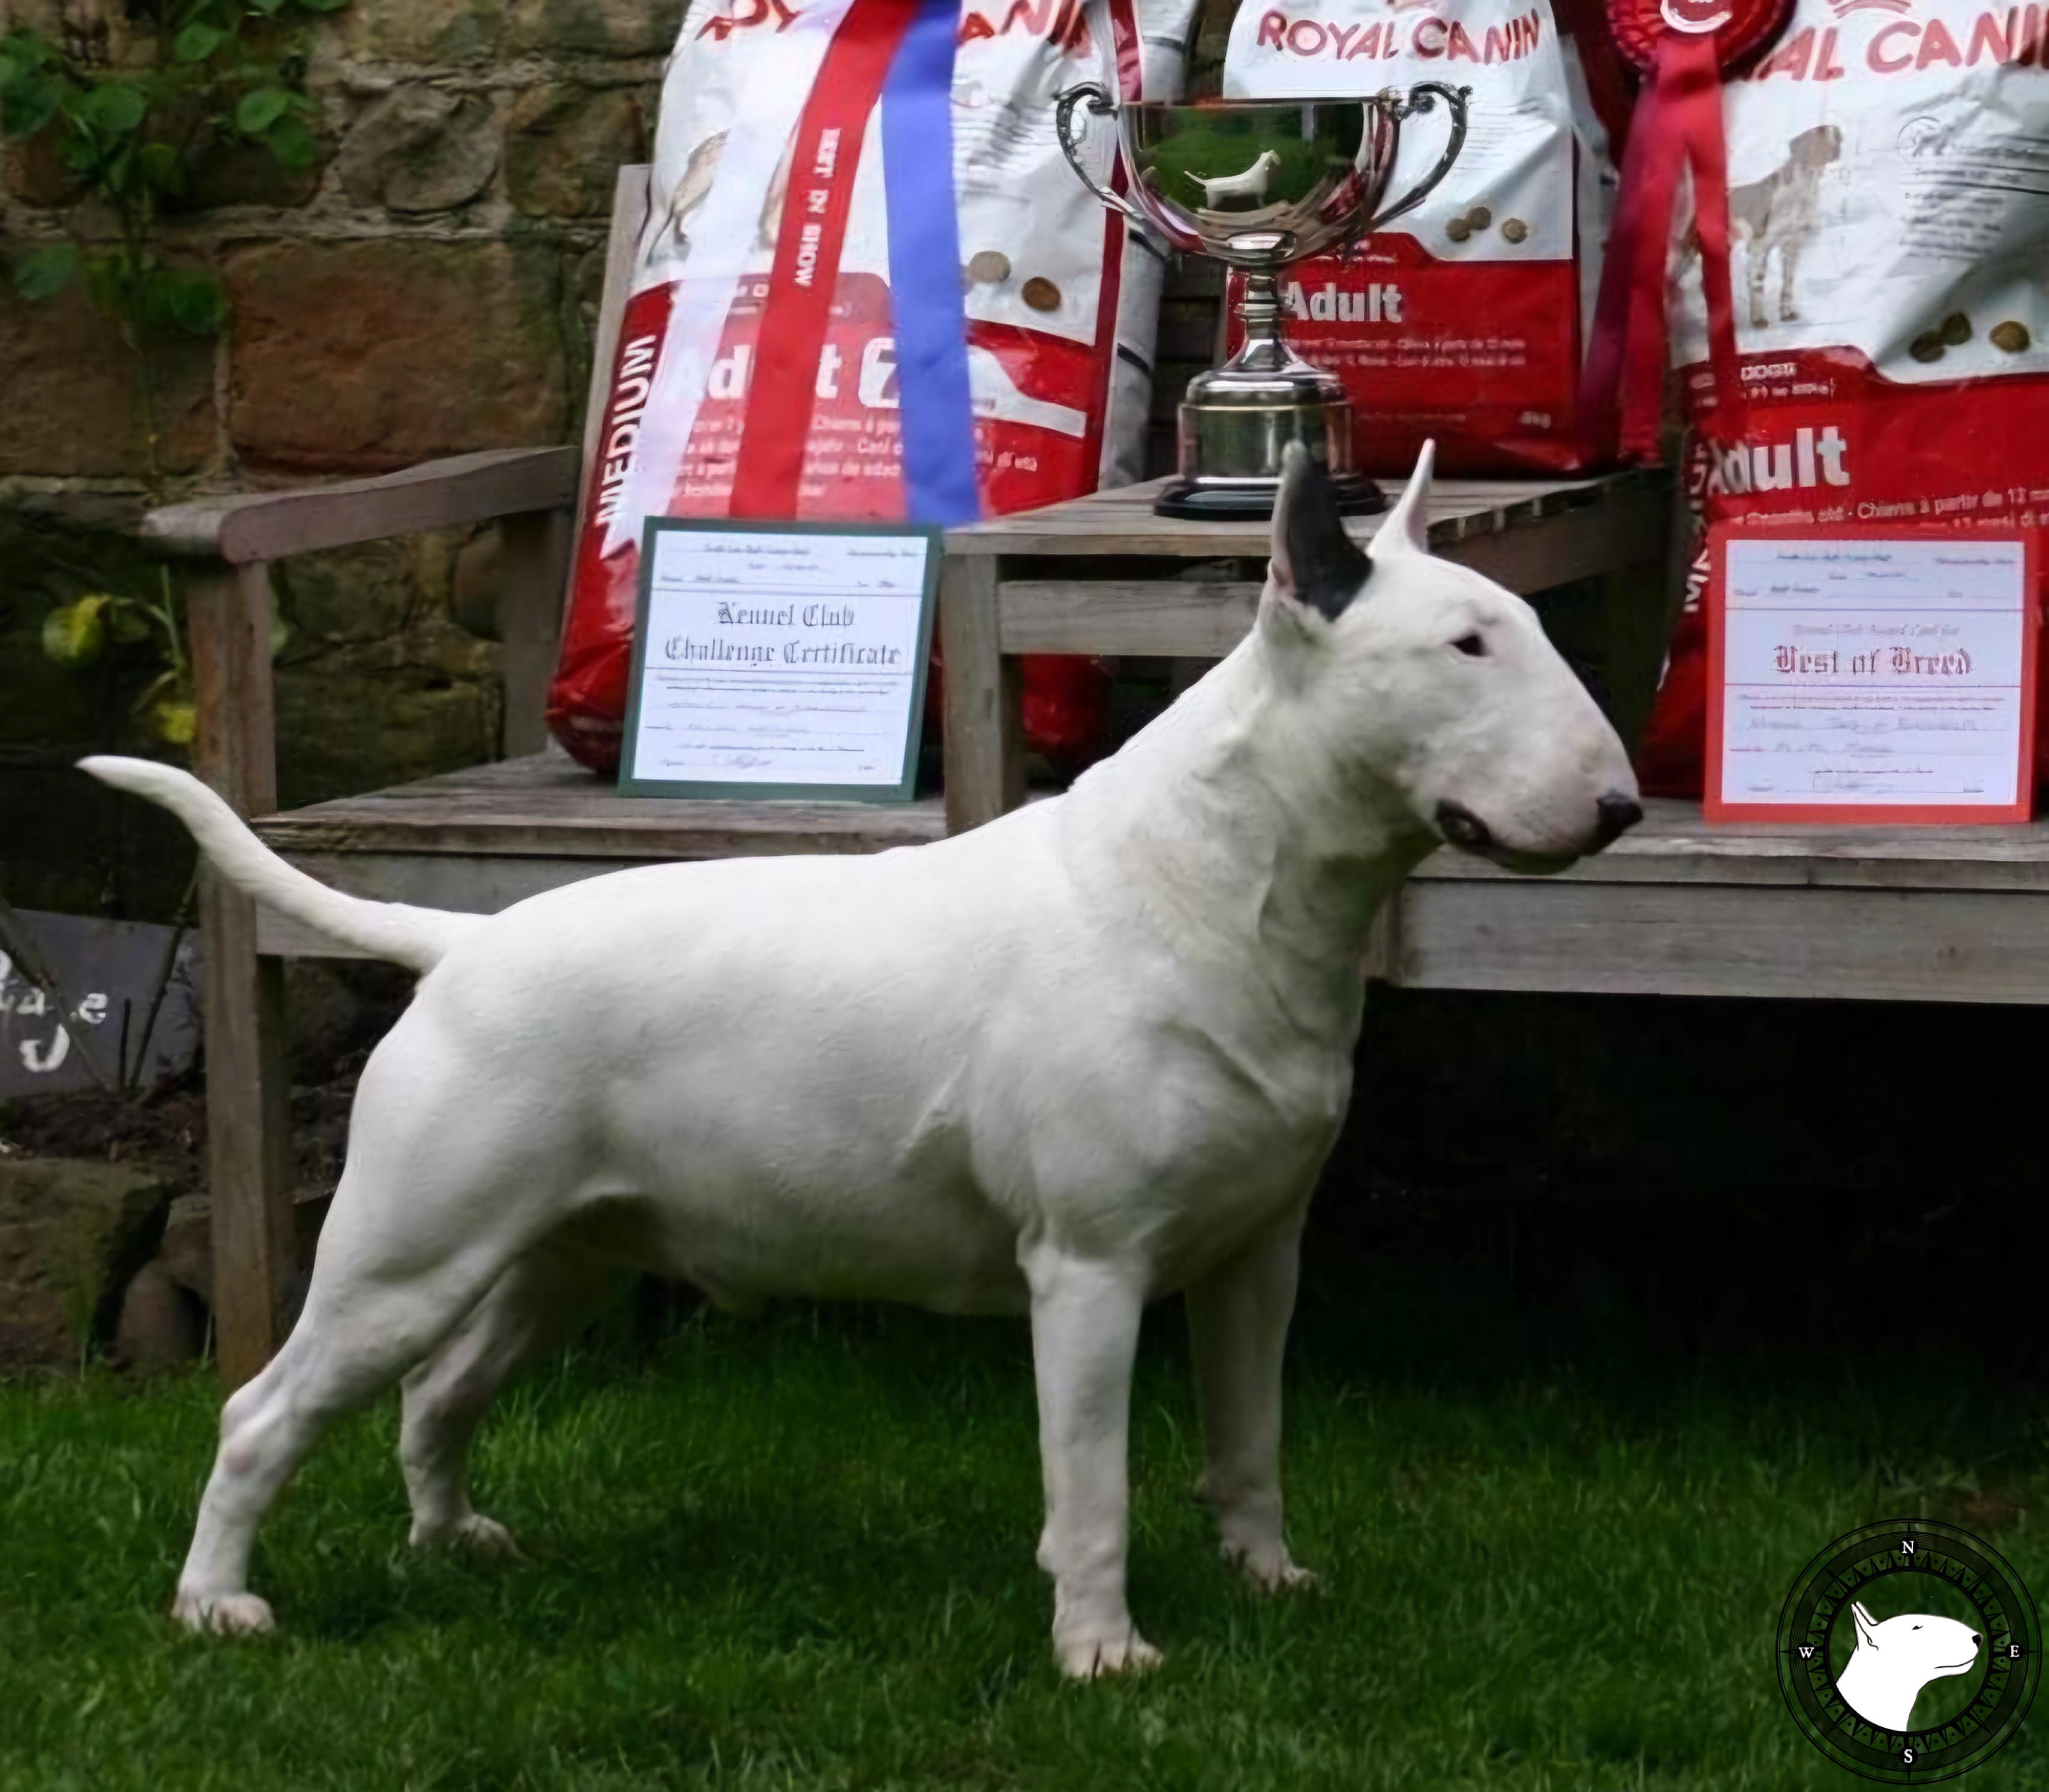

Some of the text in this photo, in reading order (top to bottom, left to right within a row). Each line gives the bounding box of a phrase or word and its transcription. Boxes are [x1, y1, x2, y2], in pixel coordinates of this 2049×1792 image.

[1257, 8, 1541, 65] ROYAL CANIN
[1757, 25, 1844, 81] AL
[1285, 281, 1403, 324] Adult
[594, 334, 657, 528] MEDIUM
[716, 602, 857, 627] Kennel Club
[664, 636, 776, 663] Challenge
[1852, 647, 1882, 675] of
